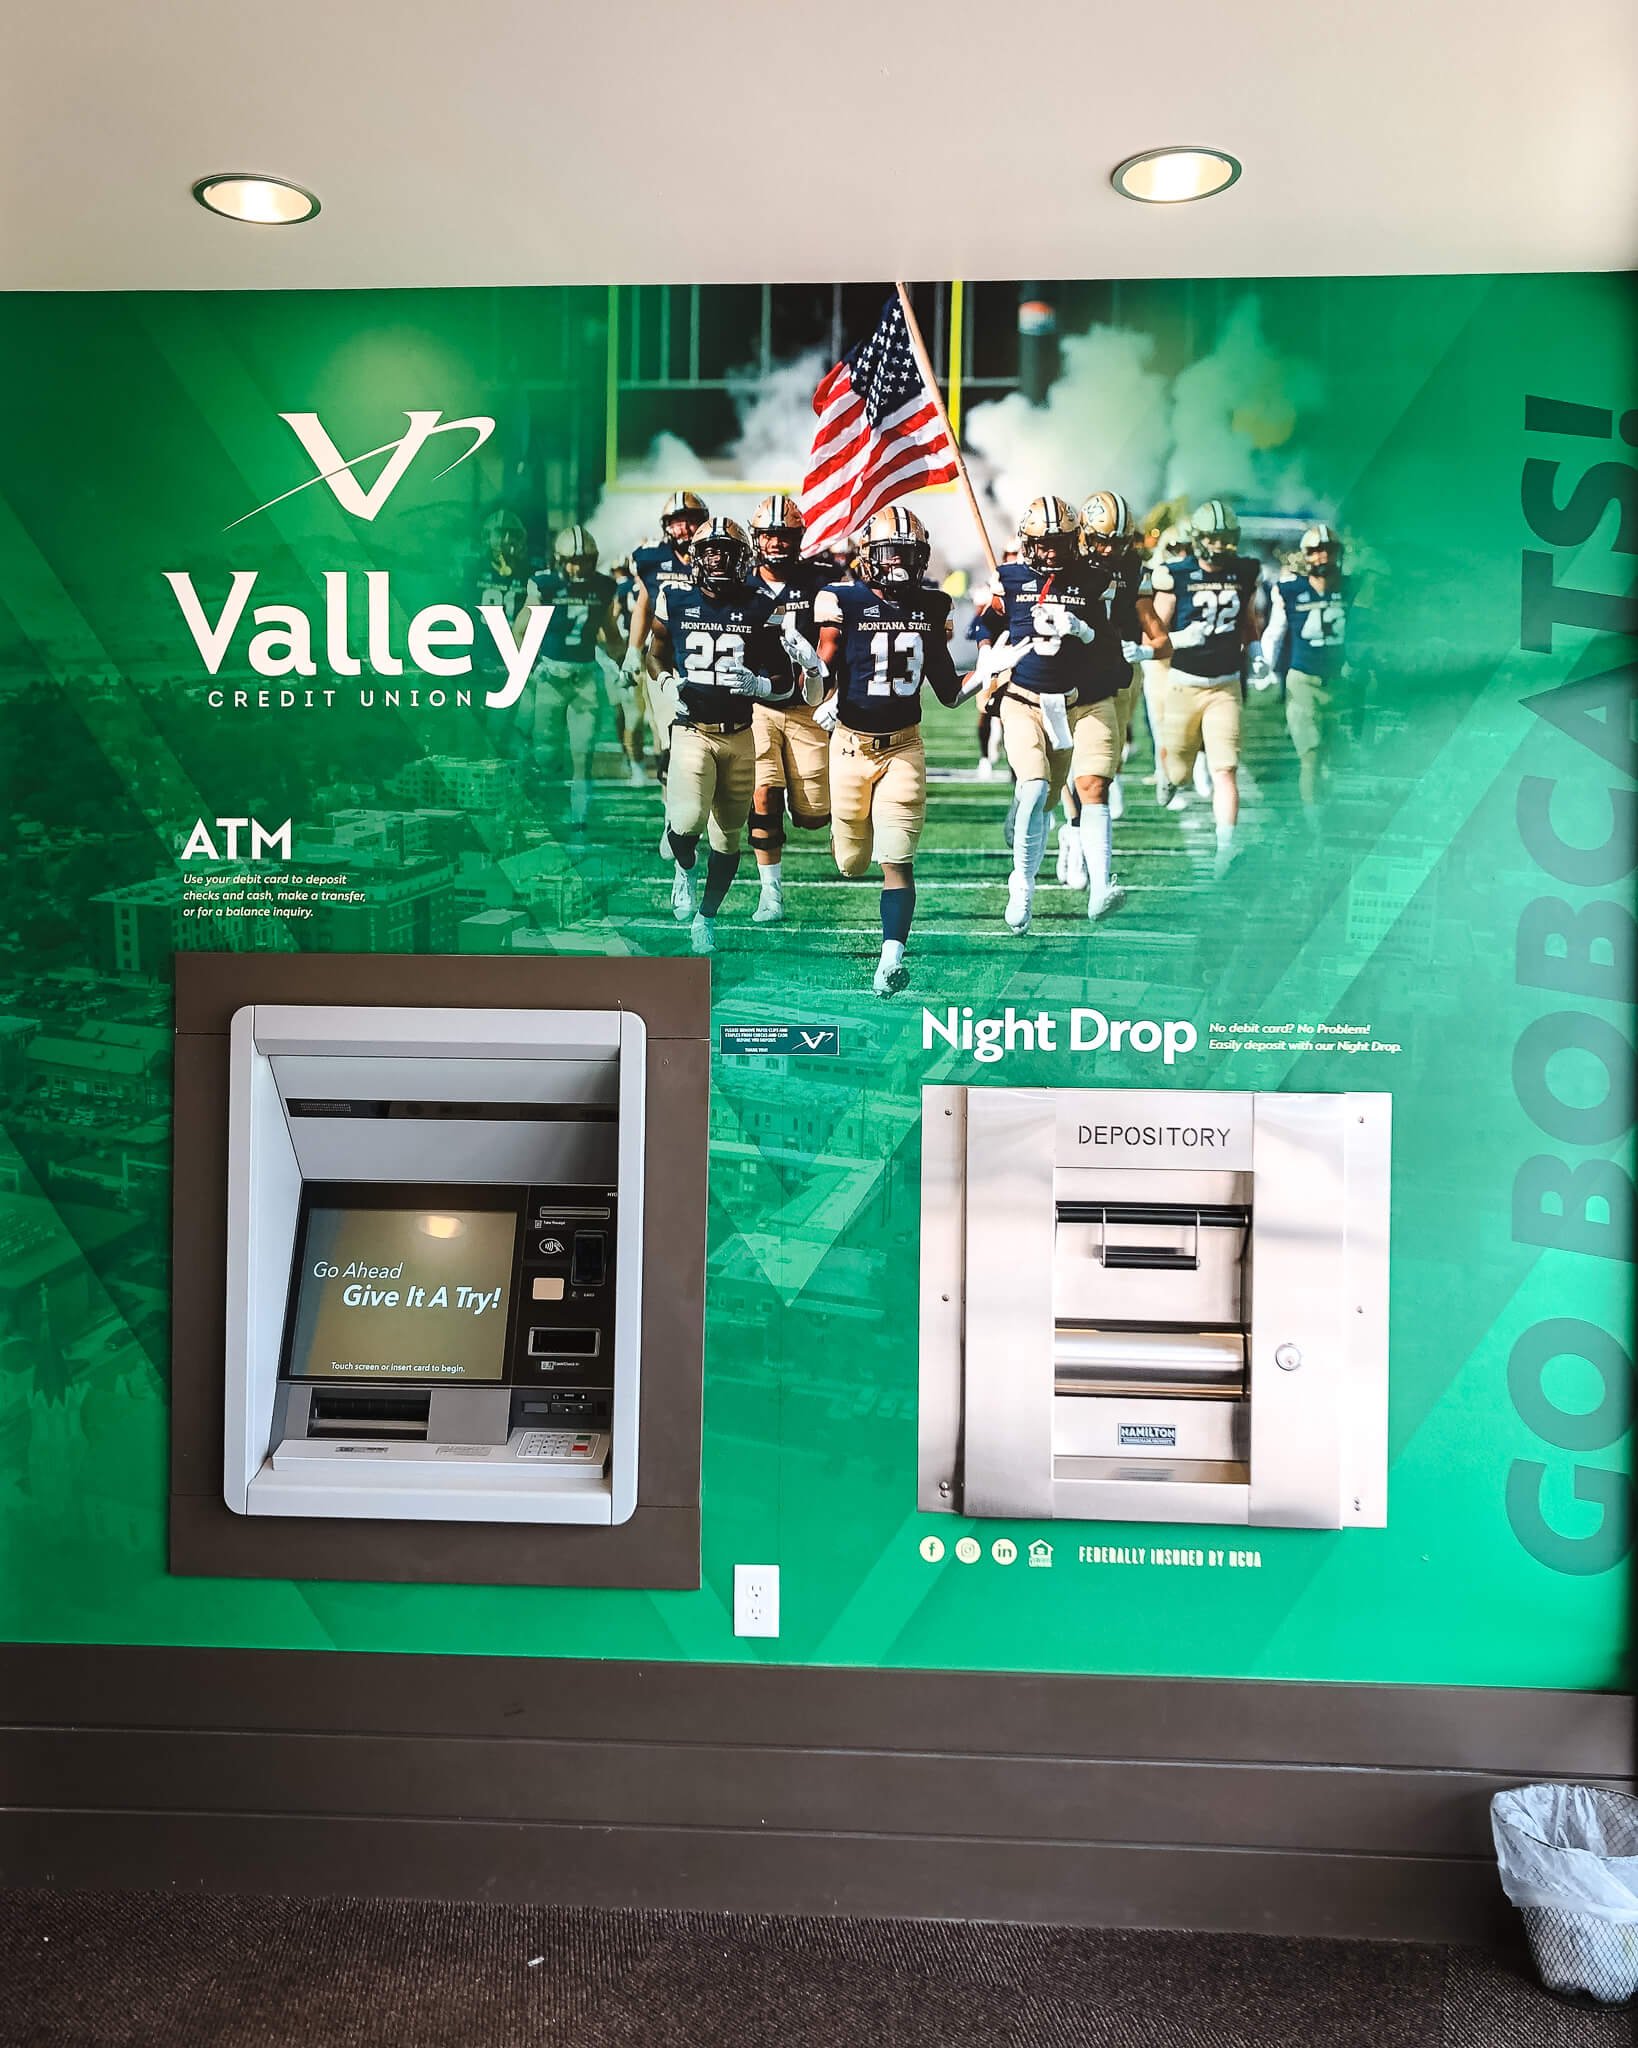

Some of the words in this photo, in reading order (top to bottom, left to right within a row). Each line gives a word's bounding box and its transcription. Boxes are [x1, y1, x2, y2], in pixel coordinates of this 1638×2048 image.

[785, 601, 810, 610] STATE
[1016, 594, 1058, 602] MONTNA
[1060, 595, 1086, 605] STATE
[680, 621, 723, 631] MONTANA
[725, 624, 752, 633] STATE
[857, 621, 906, 631] MONTANA
[908, 621, 932, 631] STATE
[161, 571, 556, 708] Valley
[684, 631, 745, 686] 22
[867, 632, 924, 697] 13
[208, 689, 337, 707] CREDIT
[360, 689, 472, 707] UNION
[181, 817, 291, 860] ATM
[1510, 394, 1638, 1265] BOBCATS!
[183, 874, 203, 884] Use
[205, 876, 230, 887] your
[232, 874, 261, 884] debit
[264, 874, 289, 884] card
[292, 876, 303, 884] to
[306, 874, 347, 886] deposit
[183, 890, 219, 900] checks
[222, 891, 244, 900] and
[247, 890, 274, 902] cash,
[277, 891, 309, 900] make
[311, 893, 318, 901] a
[321, 891, 366, 903] transfer,
[183, 908, 195, 917] or
[197, 906, 212, 919] for
[215, 909, 222, 917] a
[226, 907, 270, 917] balance
[273, 907, 314, 919] inquiry.
[922, 1006, 1057, 1063] Night
[1070, 1007, 1198, 1064] Drop
[1209, 1023, 1226, 1033] No
[1229, 1023, 1260, 1033] debit
[1262, 1023, 1295, 1034] card?
[1297, 1024, 1314, 1034] No
[1317, 1024, 1371, 1034] Problem!
[1209, 1040, 1242, 1052] Easily
[1244, 1040, 1286, 1052] deposit
[1288, 1041, 1313, 1051] with
[1315, 1043, 1336, 1051] our
[1336, 1041, 1370, 1053] Night
[1371, 1041, 1402, 1054] Drop.
[1079, 1126, 1230, 1147] DEPOSITORY
[313, 1261, 339, 1278] Go
[342, 1261, 404, 1279] Ahead
[343, 1284, 400, 1307] Give
[405, 1285, 425, 1308] It
[428, 1286, 448, 1308] A
[456, 1286, 502, 1315] Try!
[331, 1361, 353, 1370] Touch
[354, 1363, 379, 1371] screen
[391, 1362, 412, 1371] insert
[413, 1362, 430, 1372] card
[432, 1363, 440, 1372] to
[441, 1363, 466, 1374] begin.
[1121, 1427, 1175, 1438] HAMILTON
[1505, 1317, 1638, 1576] GO
[1078, 1546, 1147, 1565] FEDERALLY
[1150, 1548, 1204, 1566] INSURED
[1208, 1550, 1225, 1567] BY
